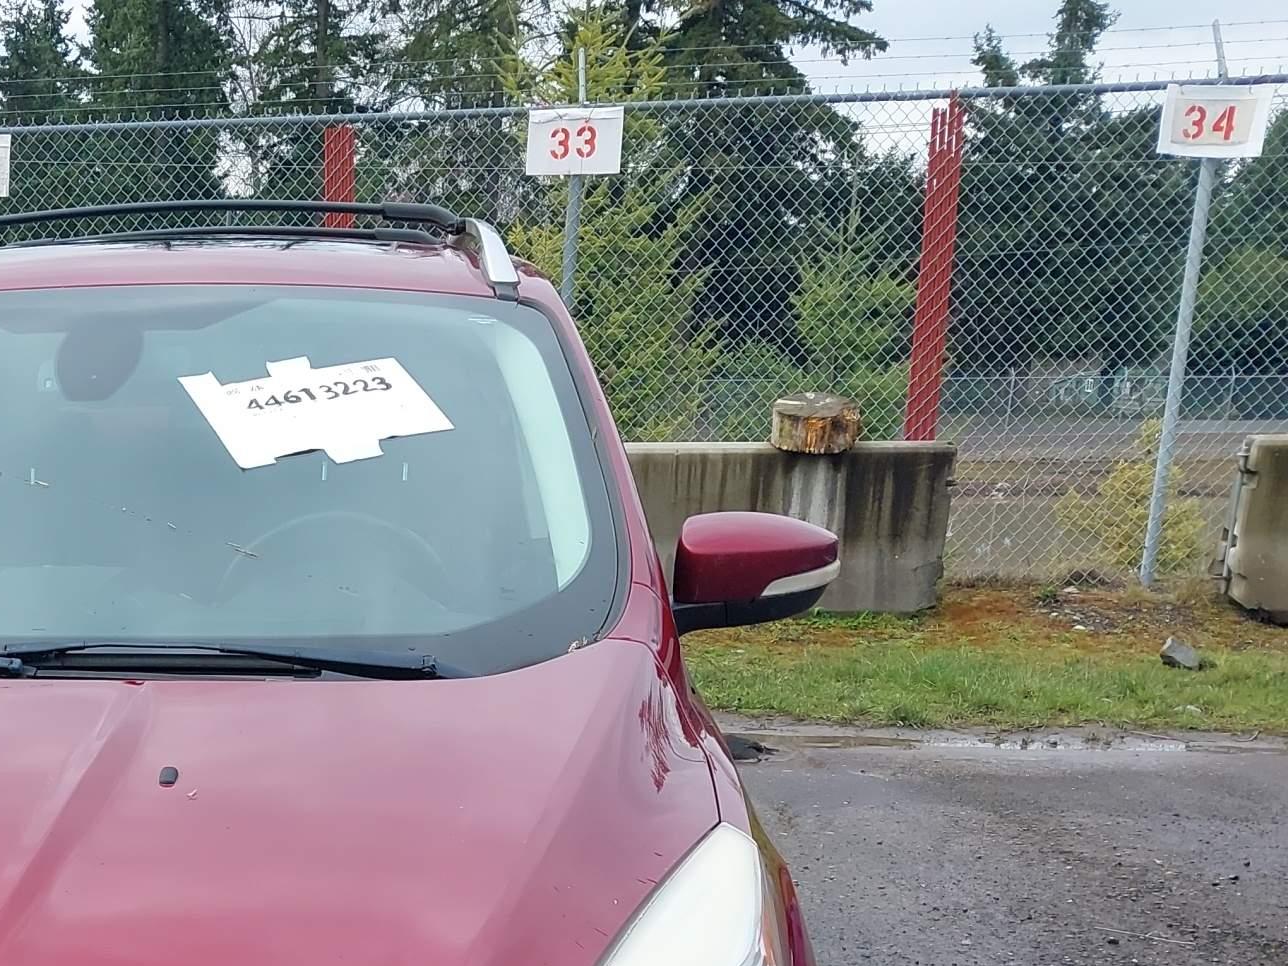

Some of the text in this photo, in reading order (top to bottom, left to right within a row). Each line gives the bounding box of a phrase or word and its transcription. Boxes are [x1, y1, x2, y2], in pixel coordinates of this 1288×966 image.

[1182, 105, 1238, 140] 34
[549, 125, 598, 160] 33
[245, 375, 394, 411] 44613223
